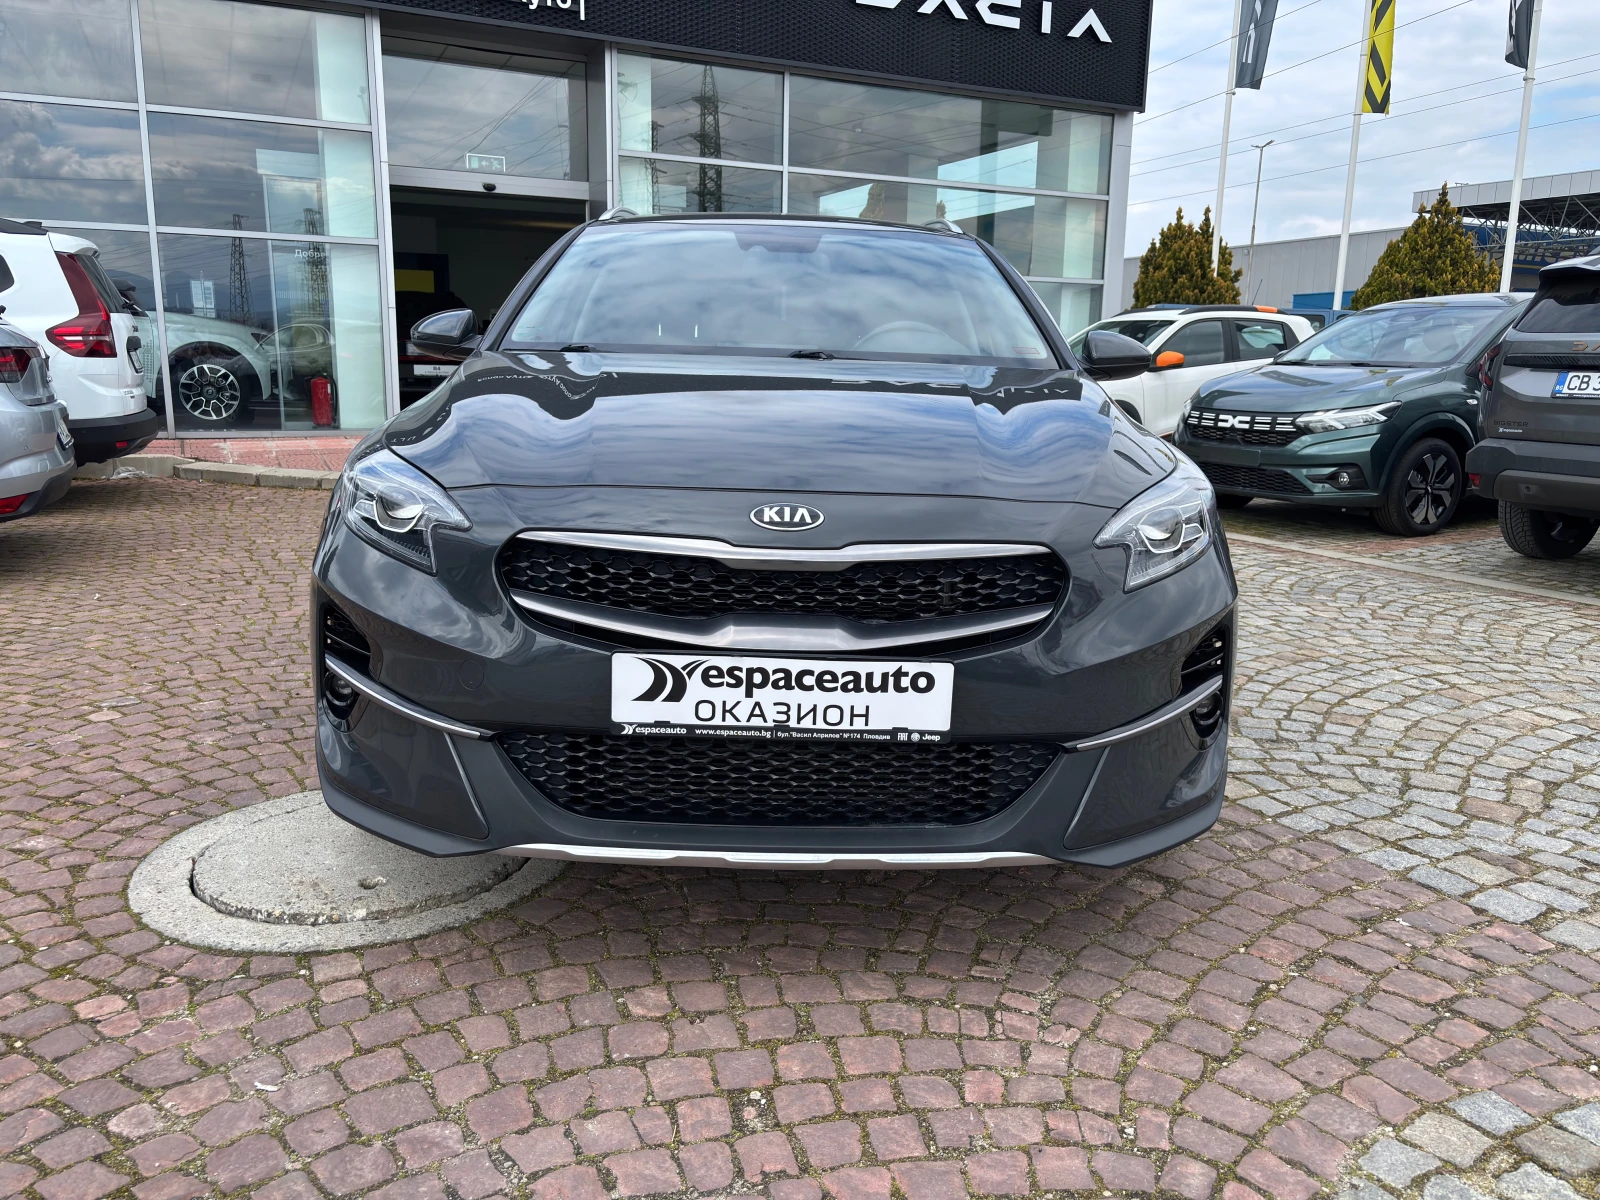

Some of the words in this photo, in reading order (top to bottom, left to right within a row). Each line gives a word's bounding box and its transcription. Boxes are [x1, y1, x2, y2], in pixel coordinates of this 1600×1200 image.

[855, 0, 1112, 43] ACIA
[1493, 420, 1529, 428] BIGSTER
[763, 506, 812, 523] KIA
[701, 664, 935, 698] espaceauto
[694, 700, 870, 727] ОКАЗИОН
[635, 726, 687, 736] espaceauto
[695, 728, 772, 738] www.espaceauto.bg
[922, 734, 941, 742] Jeep
